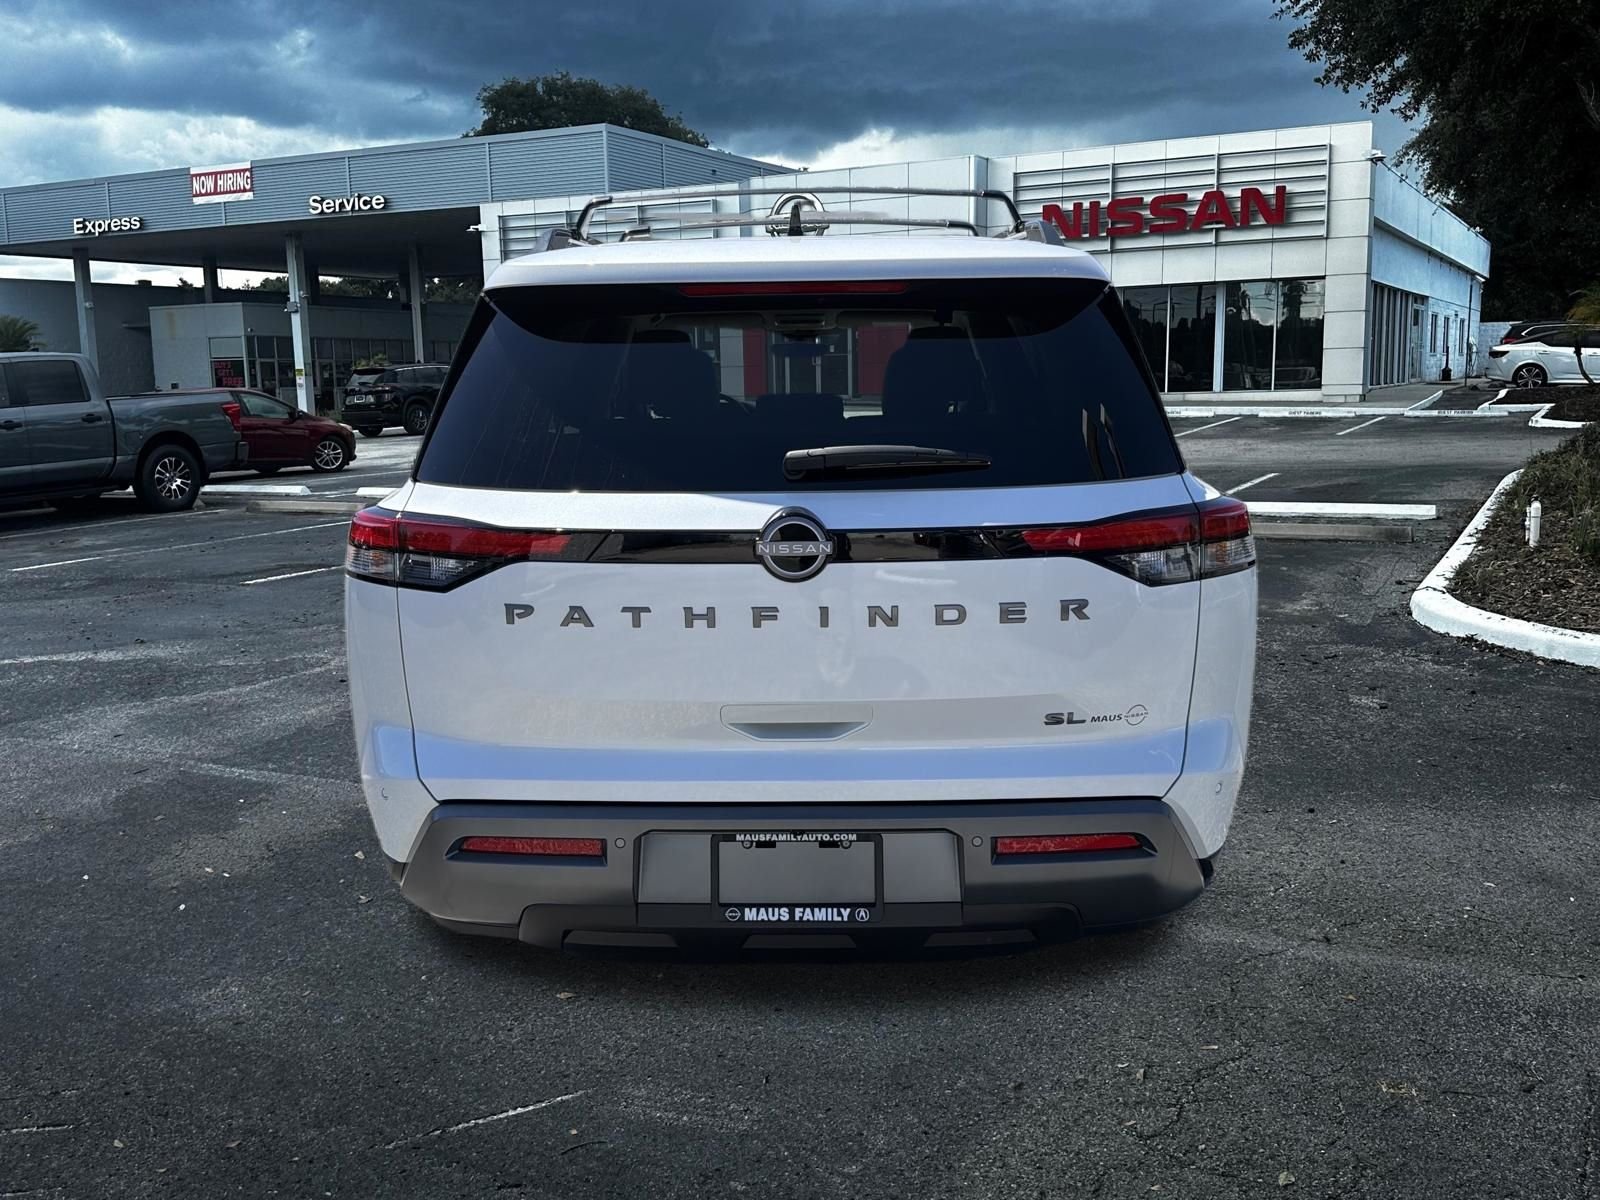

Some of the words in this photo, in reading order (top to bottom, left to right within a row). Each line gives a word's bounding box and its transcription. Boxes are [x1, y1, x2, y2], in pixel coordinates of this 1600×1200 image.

[192, 174, 215, 195] NOW
[217, 171, 251, 192] HIRING
[308, 193, 386, 215] Service
[1042, 185, 1287, 240] NISSAN
[73, 216, 141, 237] Express
[223, 376, 244, 387] FREE
[758, 543, 831, 554] NISSAN
[504, 598, 1091, 628] PATHFINDER
[1043, 711, 1087, 726] SL
[1090, 713, 1123, 723] MAUS
[735, 833, 857, 842] MAUSFAMILYAUTO.COM
[744, 907, 790, 921] MAUS
[794, 907, 851, 921] FAMILY
